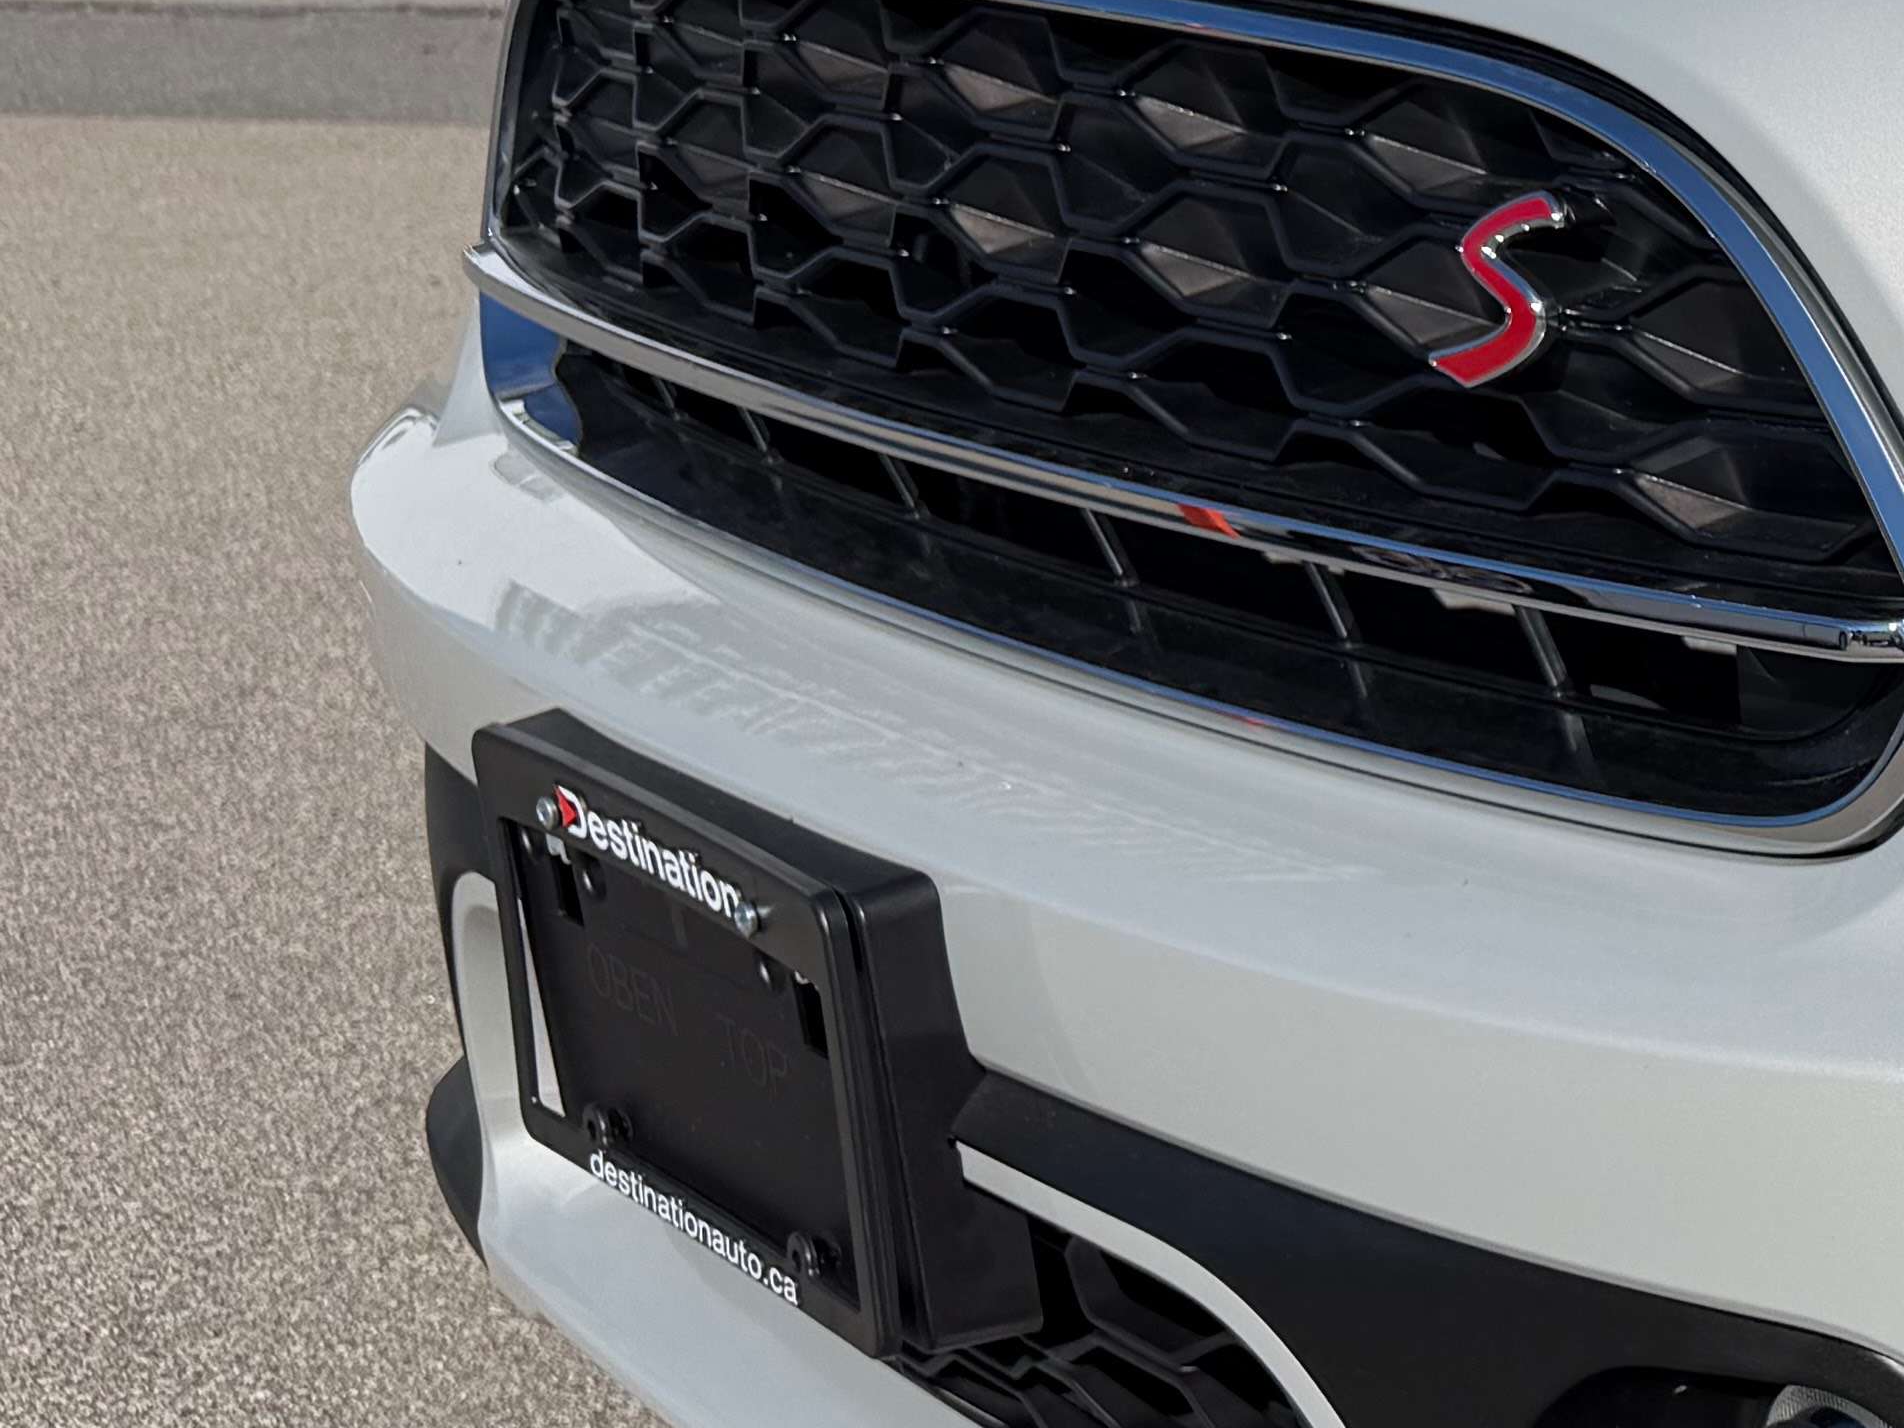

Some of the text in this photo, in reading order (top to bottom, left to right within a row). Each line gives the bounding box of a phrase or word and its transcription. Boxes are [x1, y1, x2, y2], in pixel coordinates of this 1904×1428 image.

[1427, 189, 1566, 389] S
[554, 784, 740, 919] Destination
[586, 942, 679, 1037] OBEN
[589, 1148, 799, 1306] destinationauto.ca
